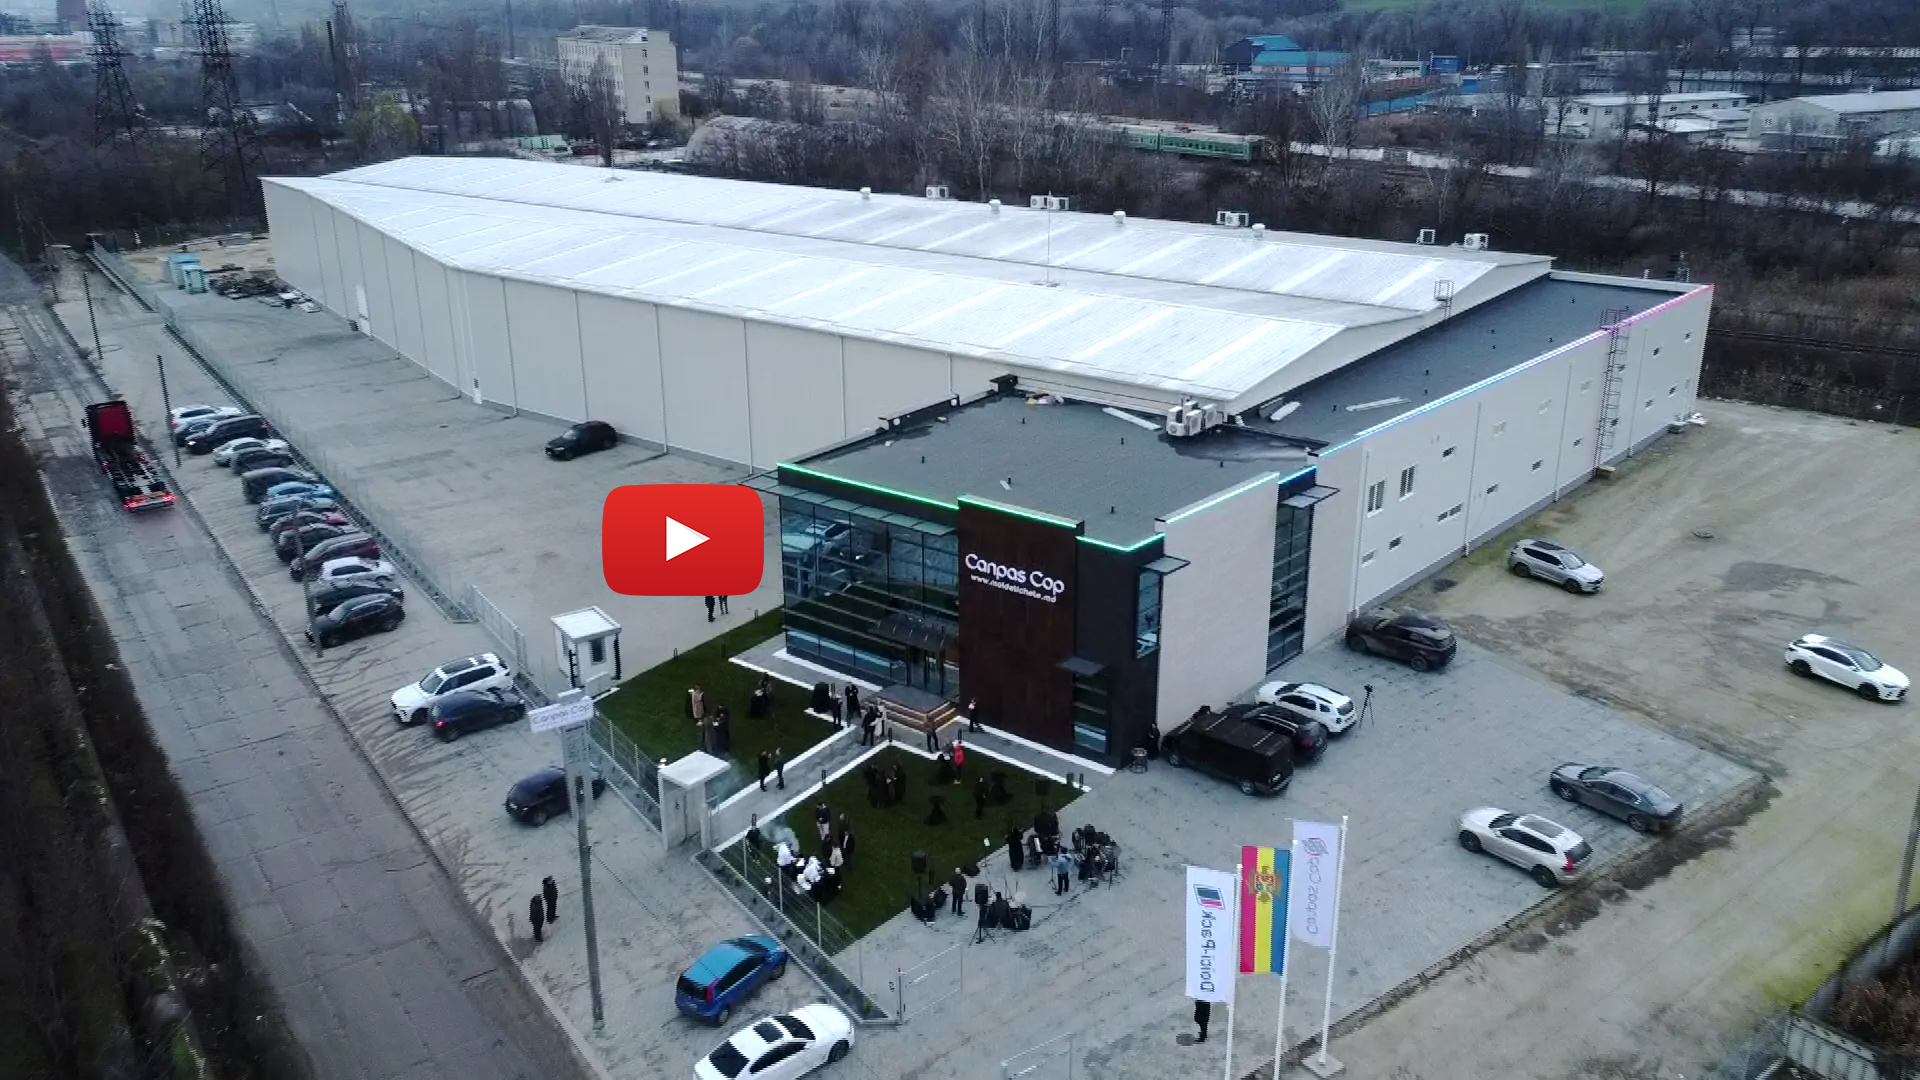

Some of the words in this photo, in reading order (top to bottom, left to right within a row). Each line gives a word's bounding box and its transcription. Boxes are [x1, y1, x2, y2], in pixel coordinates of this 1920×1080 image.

[965, 553, 1027, 583] Canpas
[1029, 571, 1065, 595] Cop
[571, 703, 591, 716] Cop
